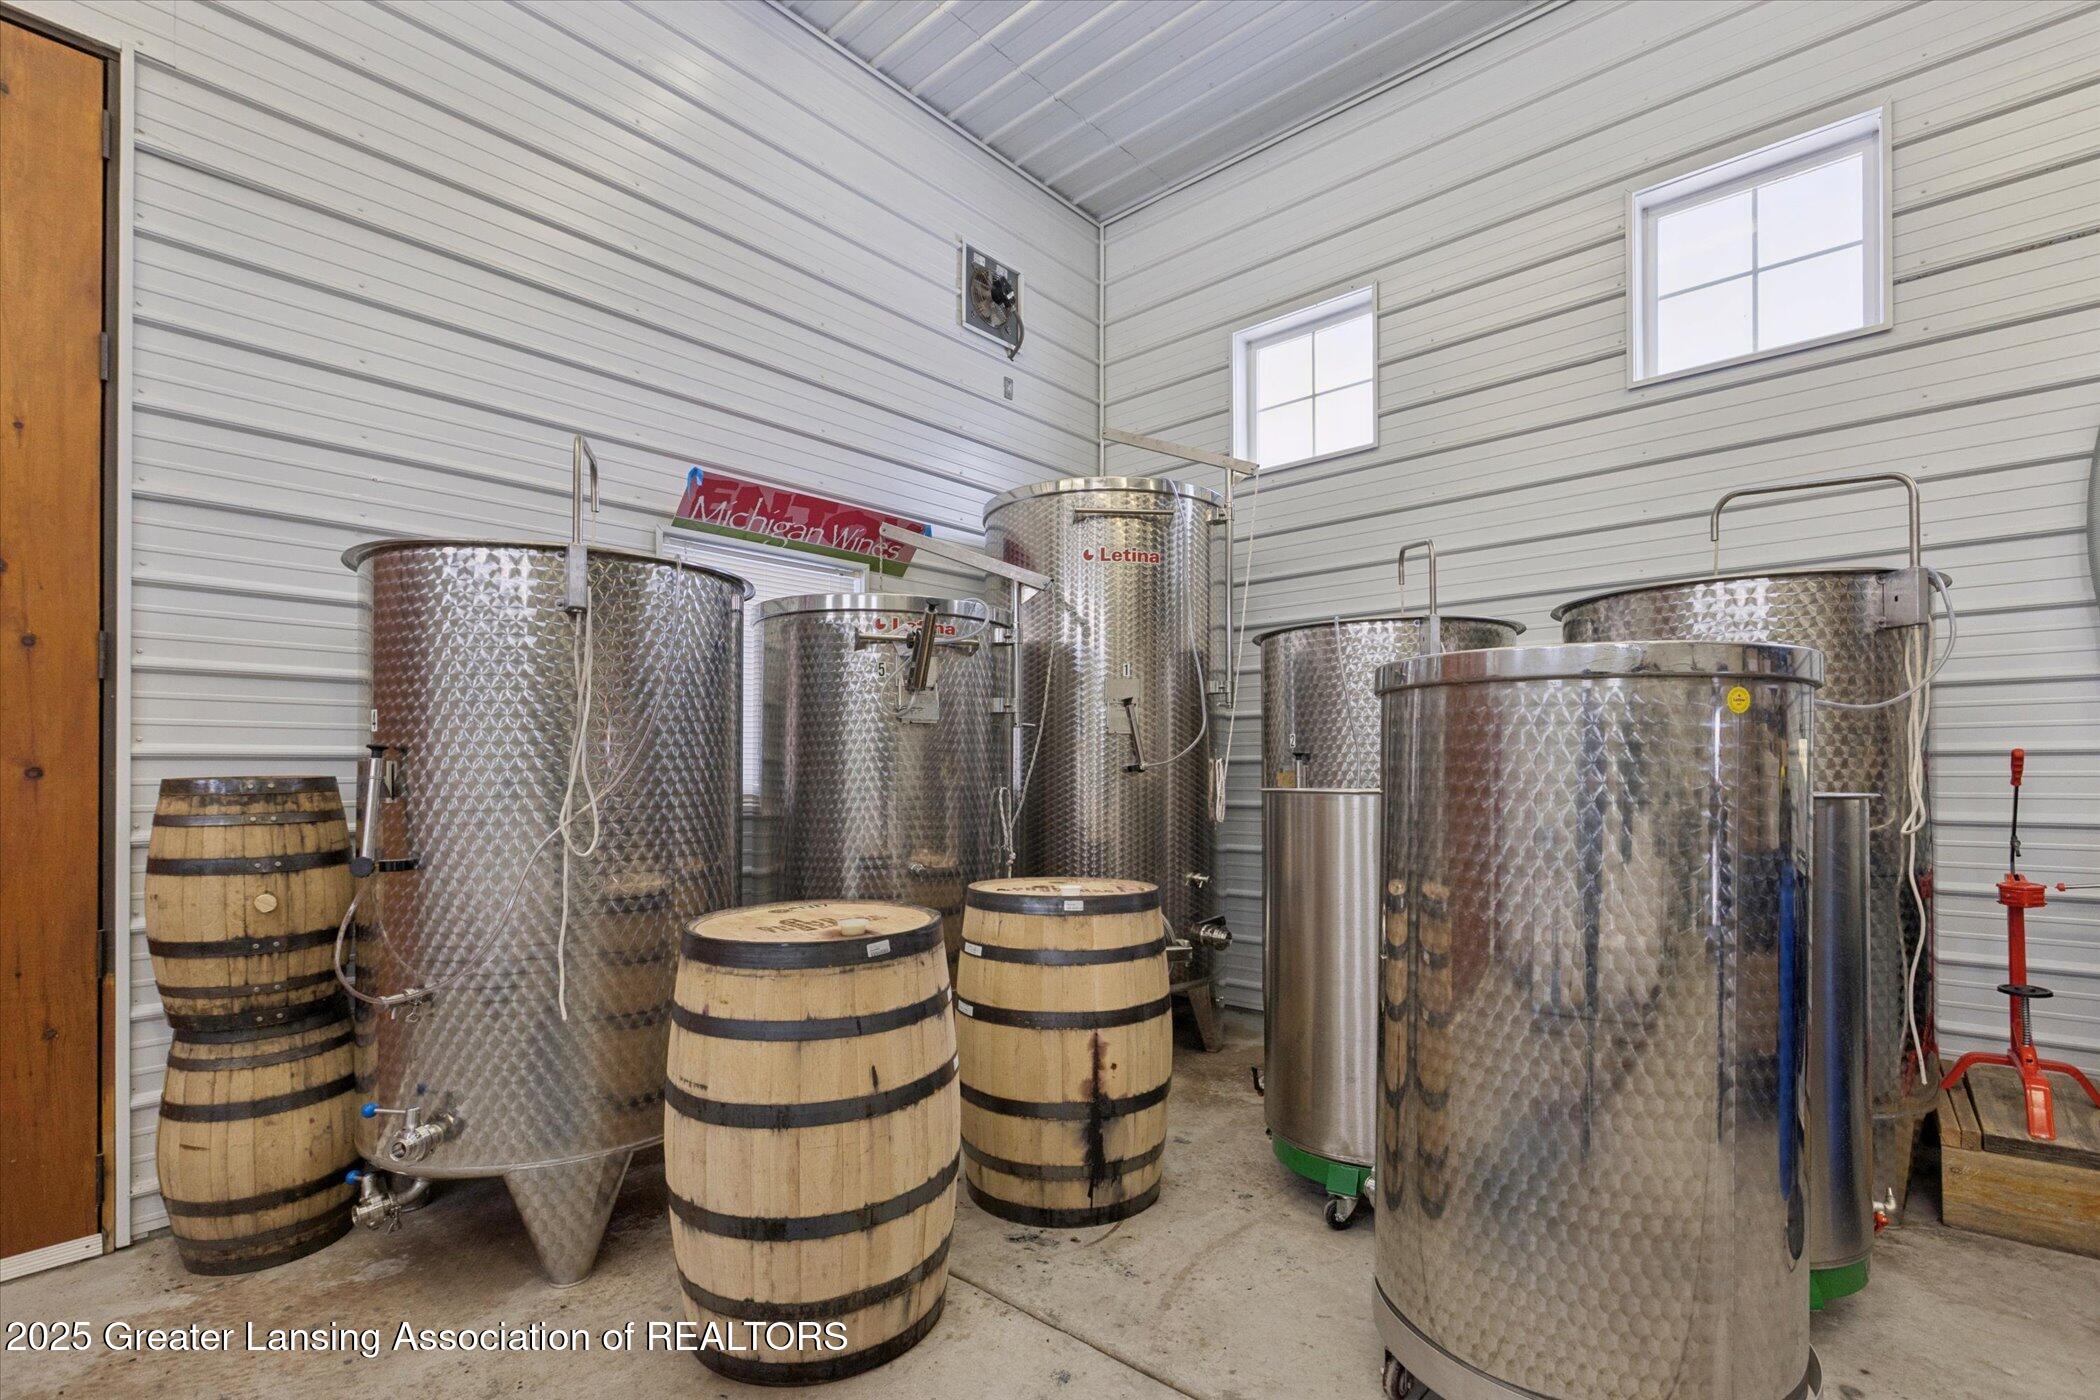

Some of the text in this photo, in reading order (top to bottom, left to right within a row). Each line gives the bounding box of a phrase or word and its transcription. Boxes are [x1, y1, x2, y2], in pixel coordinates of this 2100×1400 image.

[690, 495, 901, 560] Michigan Wines
[1100, 546, 1160, 564] Letina
[892, 616, 956, 636] Lna
[878, 662, 886, 677] 5
